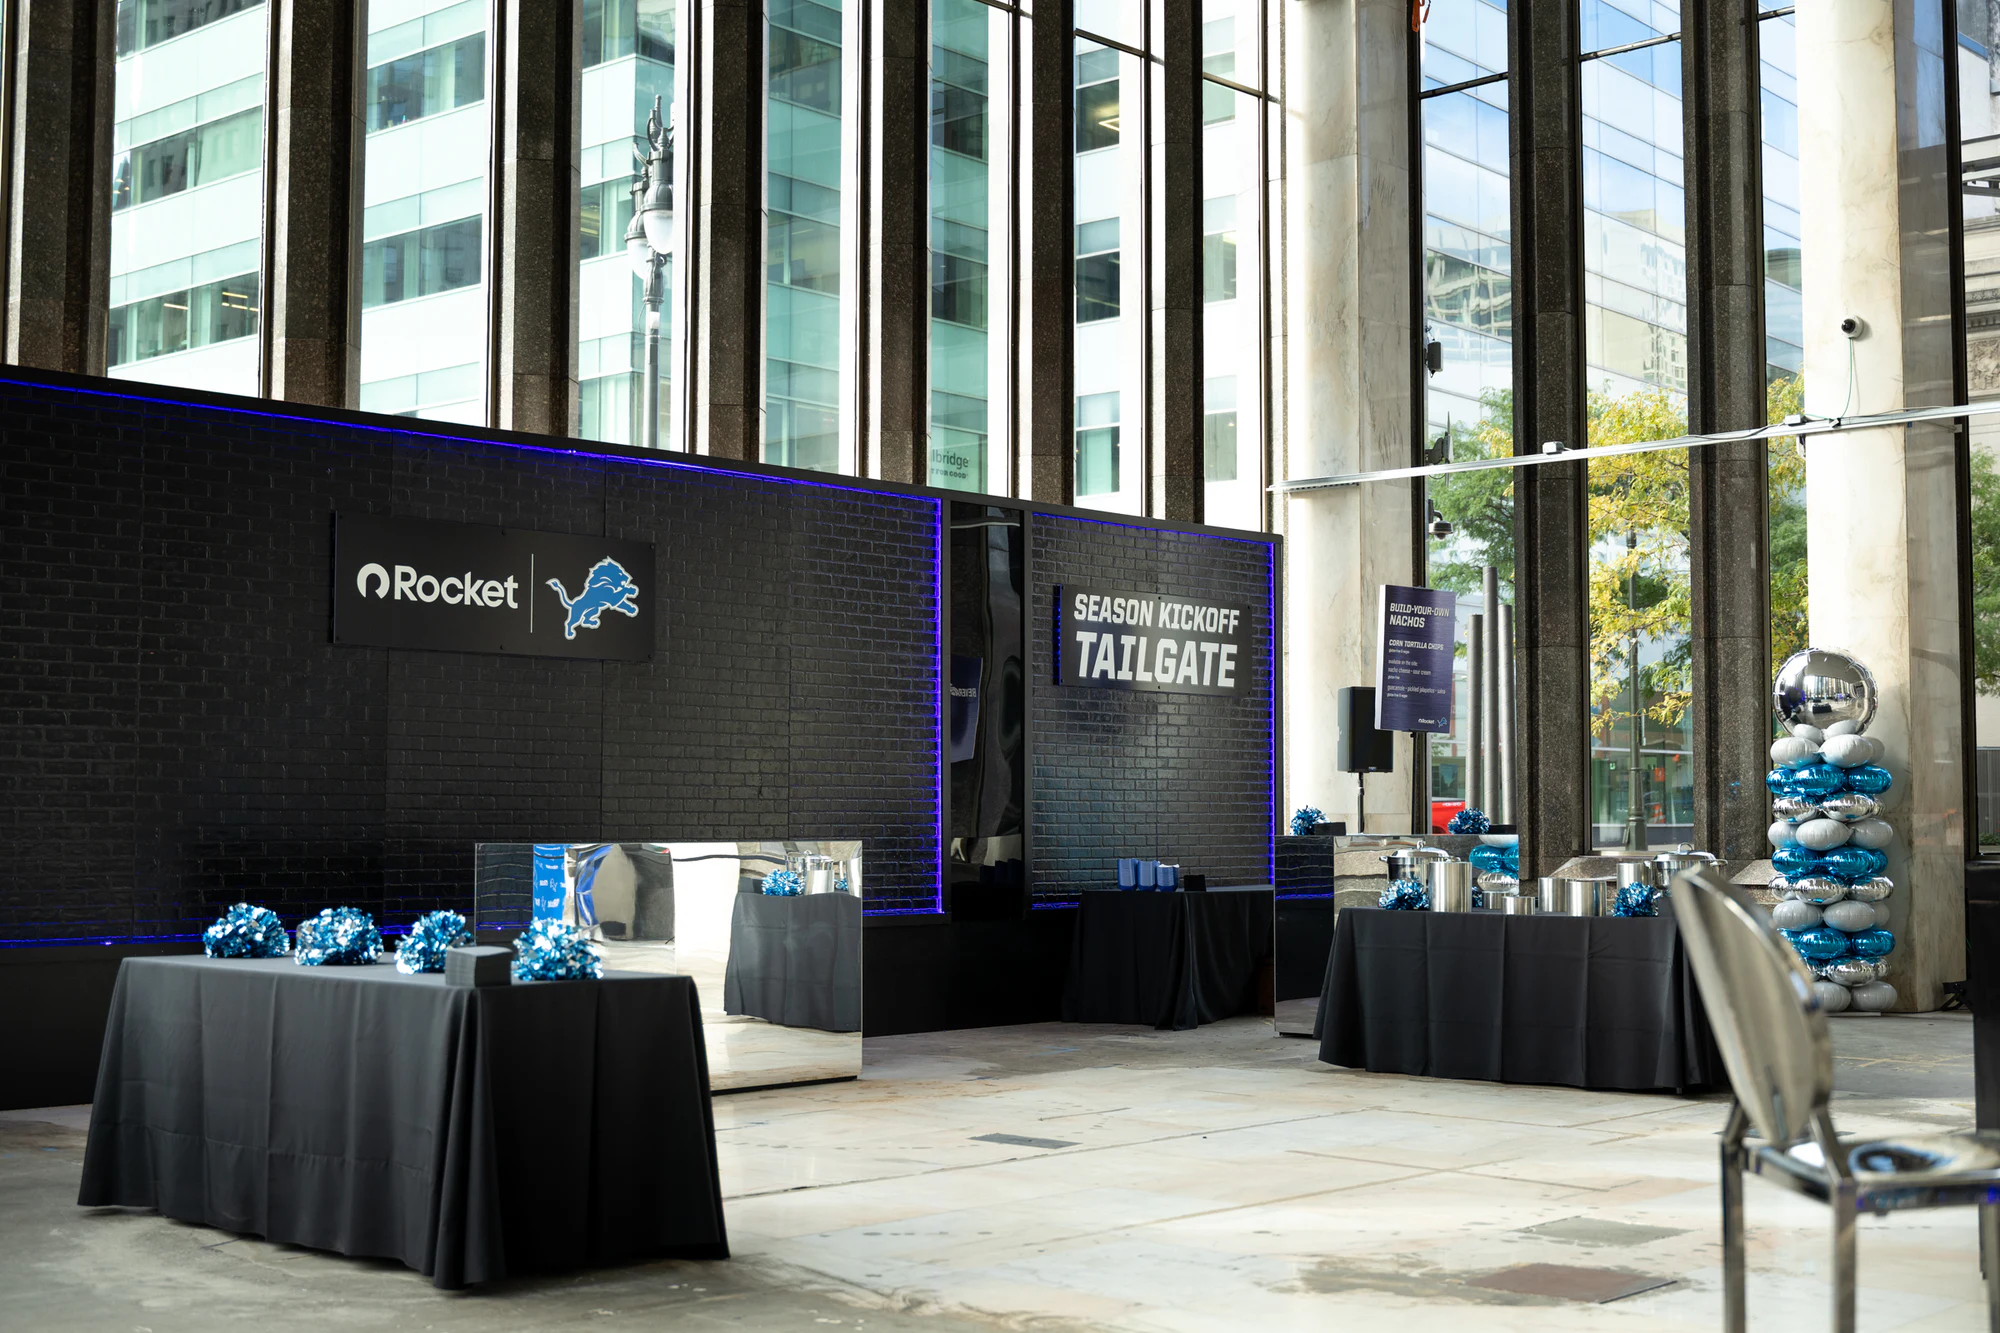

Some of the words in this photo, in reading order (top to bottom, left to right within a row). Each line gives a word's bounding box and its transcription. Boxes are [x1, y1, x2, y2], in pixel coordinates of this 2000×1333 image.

[394, 564, 519, 609] Rocket
[1073, 593, 1154, 627] SEASON
[1158, 602, 1240, 634] KICKOFF
[1389, 602, 1450, 617] BUILD-YOUR-OWN
[1389, 614, 1426, 628] NACHOS
[1076, 631, 1238, 688] TAILGATE
[1404, 640, 1427, 649] TORTILLA
[1427, 642, 1444, 651] CHIPS
